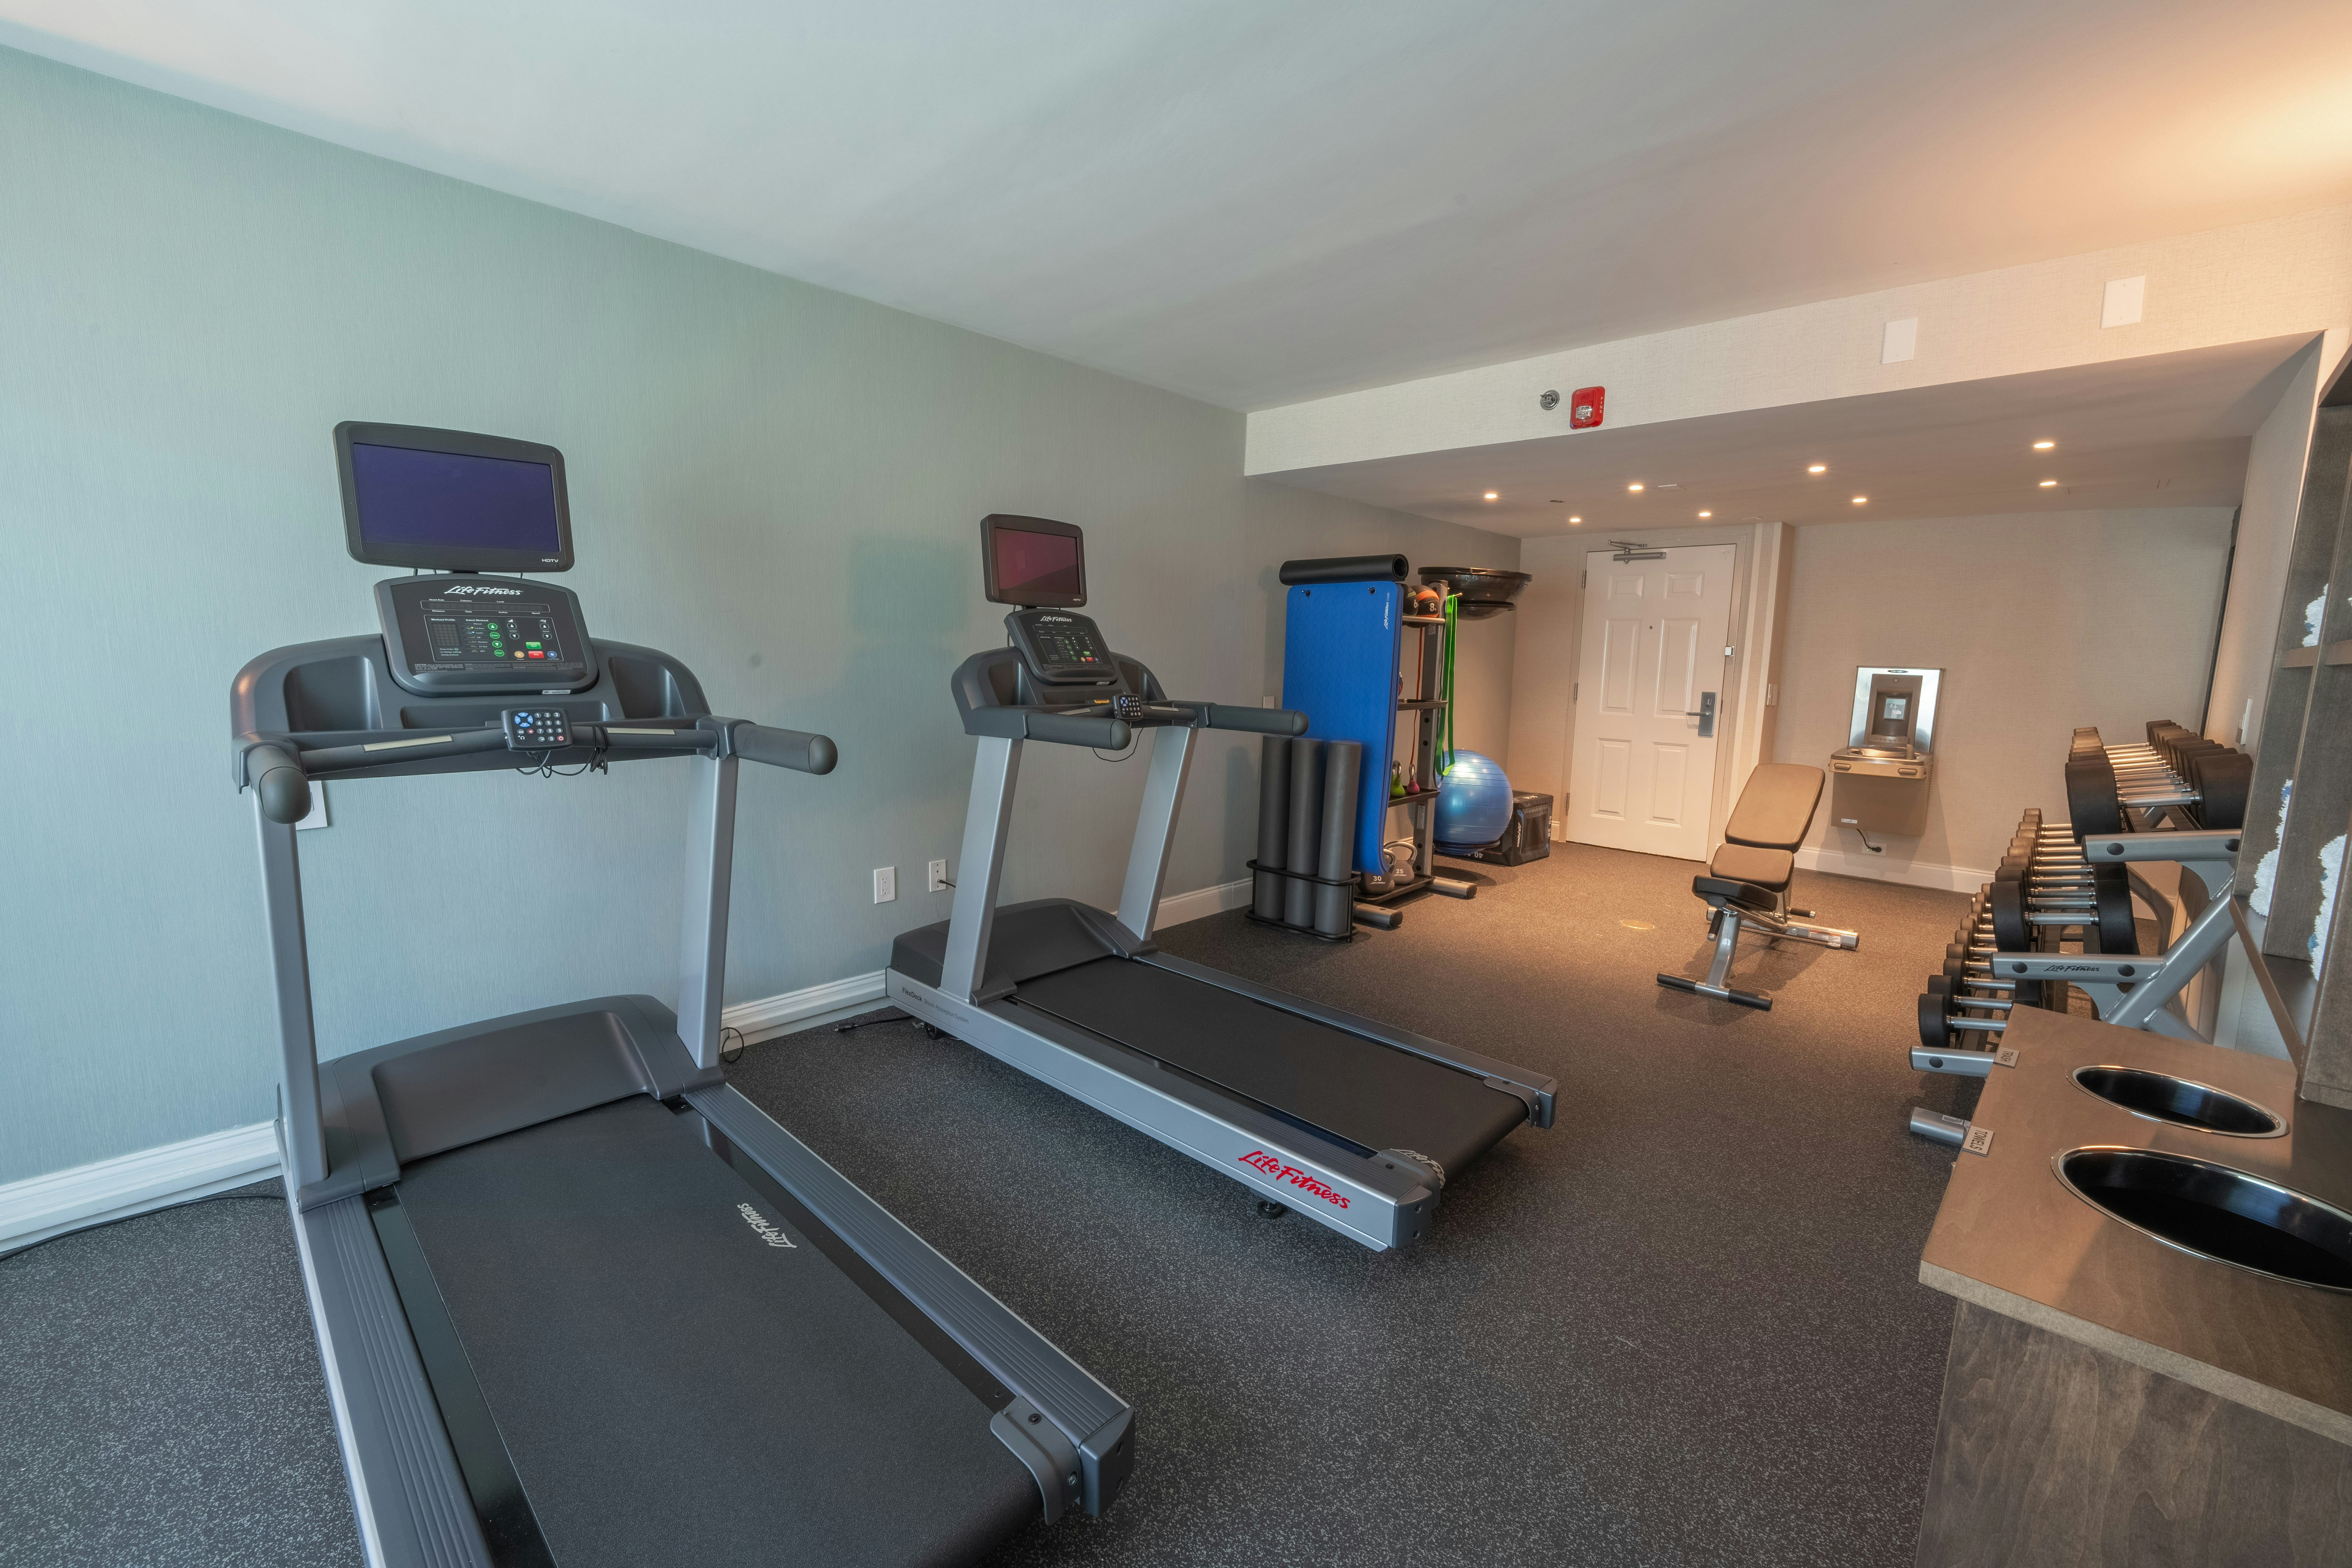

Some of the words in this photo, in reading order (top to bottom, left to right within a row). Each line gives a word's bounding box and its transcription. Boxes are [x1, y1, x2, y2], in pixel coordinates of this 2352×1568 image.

[1430, 603, 1434, 612] 8
[902, 987, 922, 1002] FlexDeck
[924, 999, 935, 1008] Shock
[935, 1005, 955, 1018] Absorption
[955, 1013, 969, 1024] System
[2000, 1050, 2014, 1063] TRASH
[1970, 1130, 1988, 1150] TOWELS
